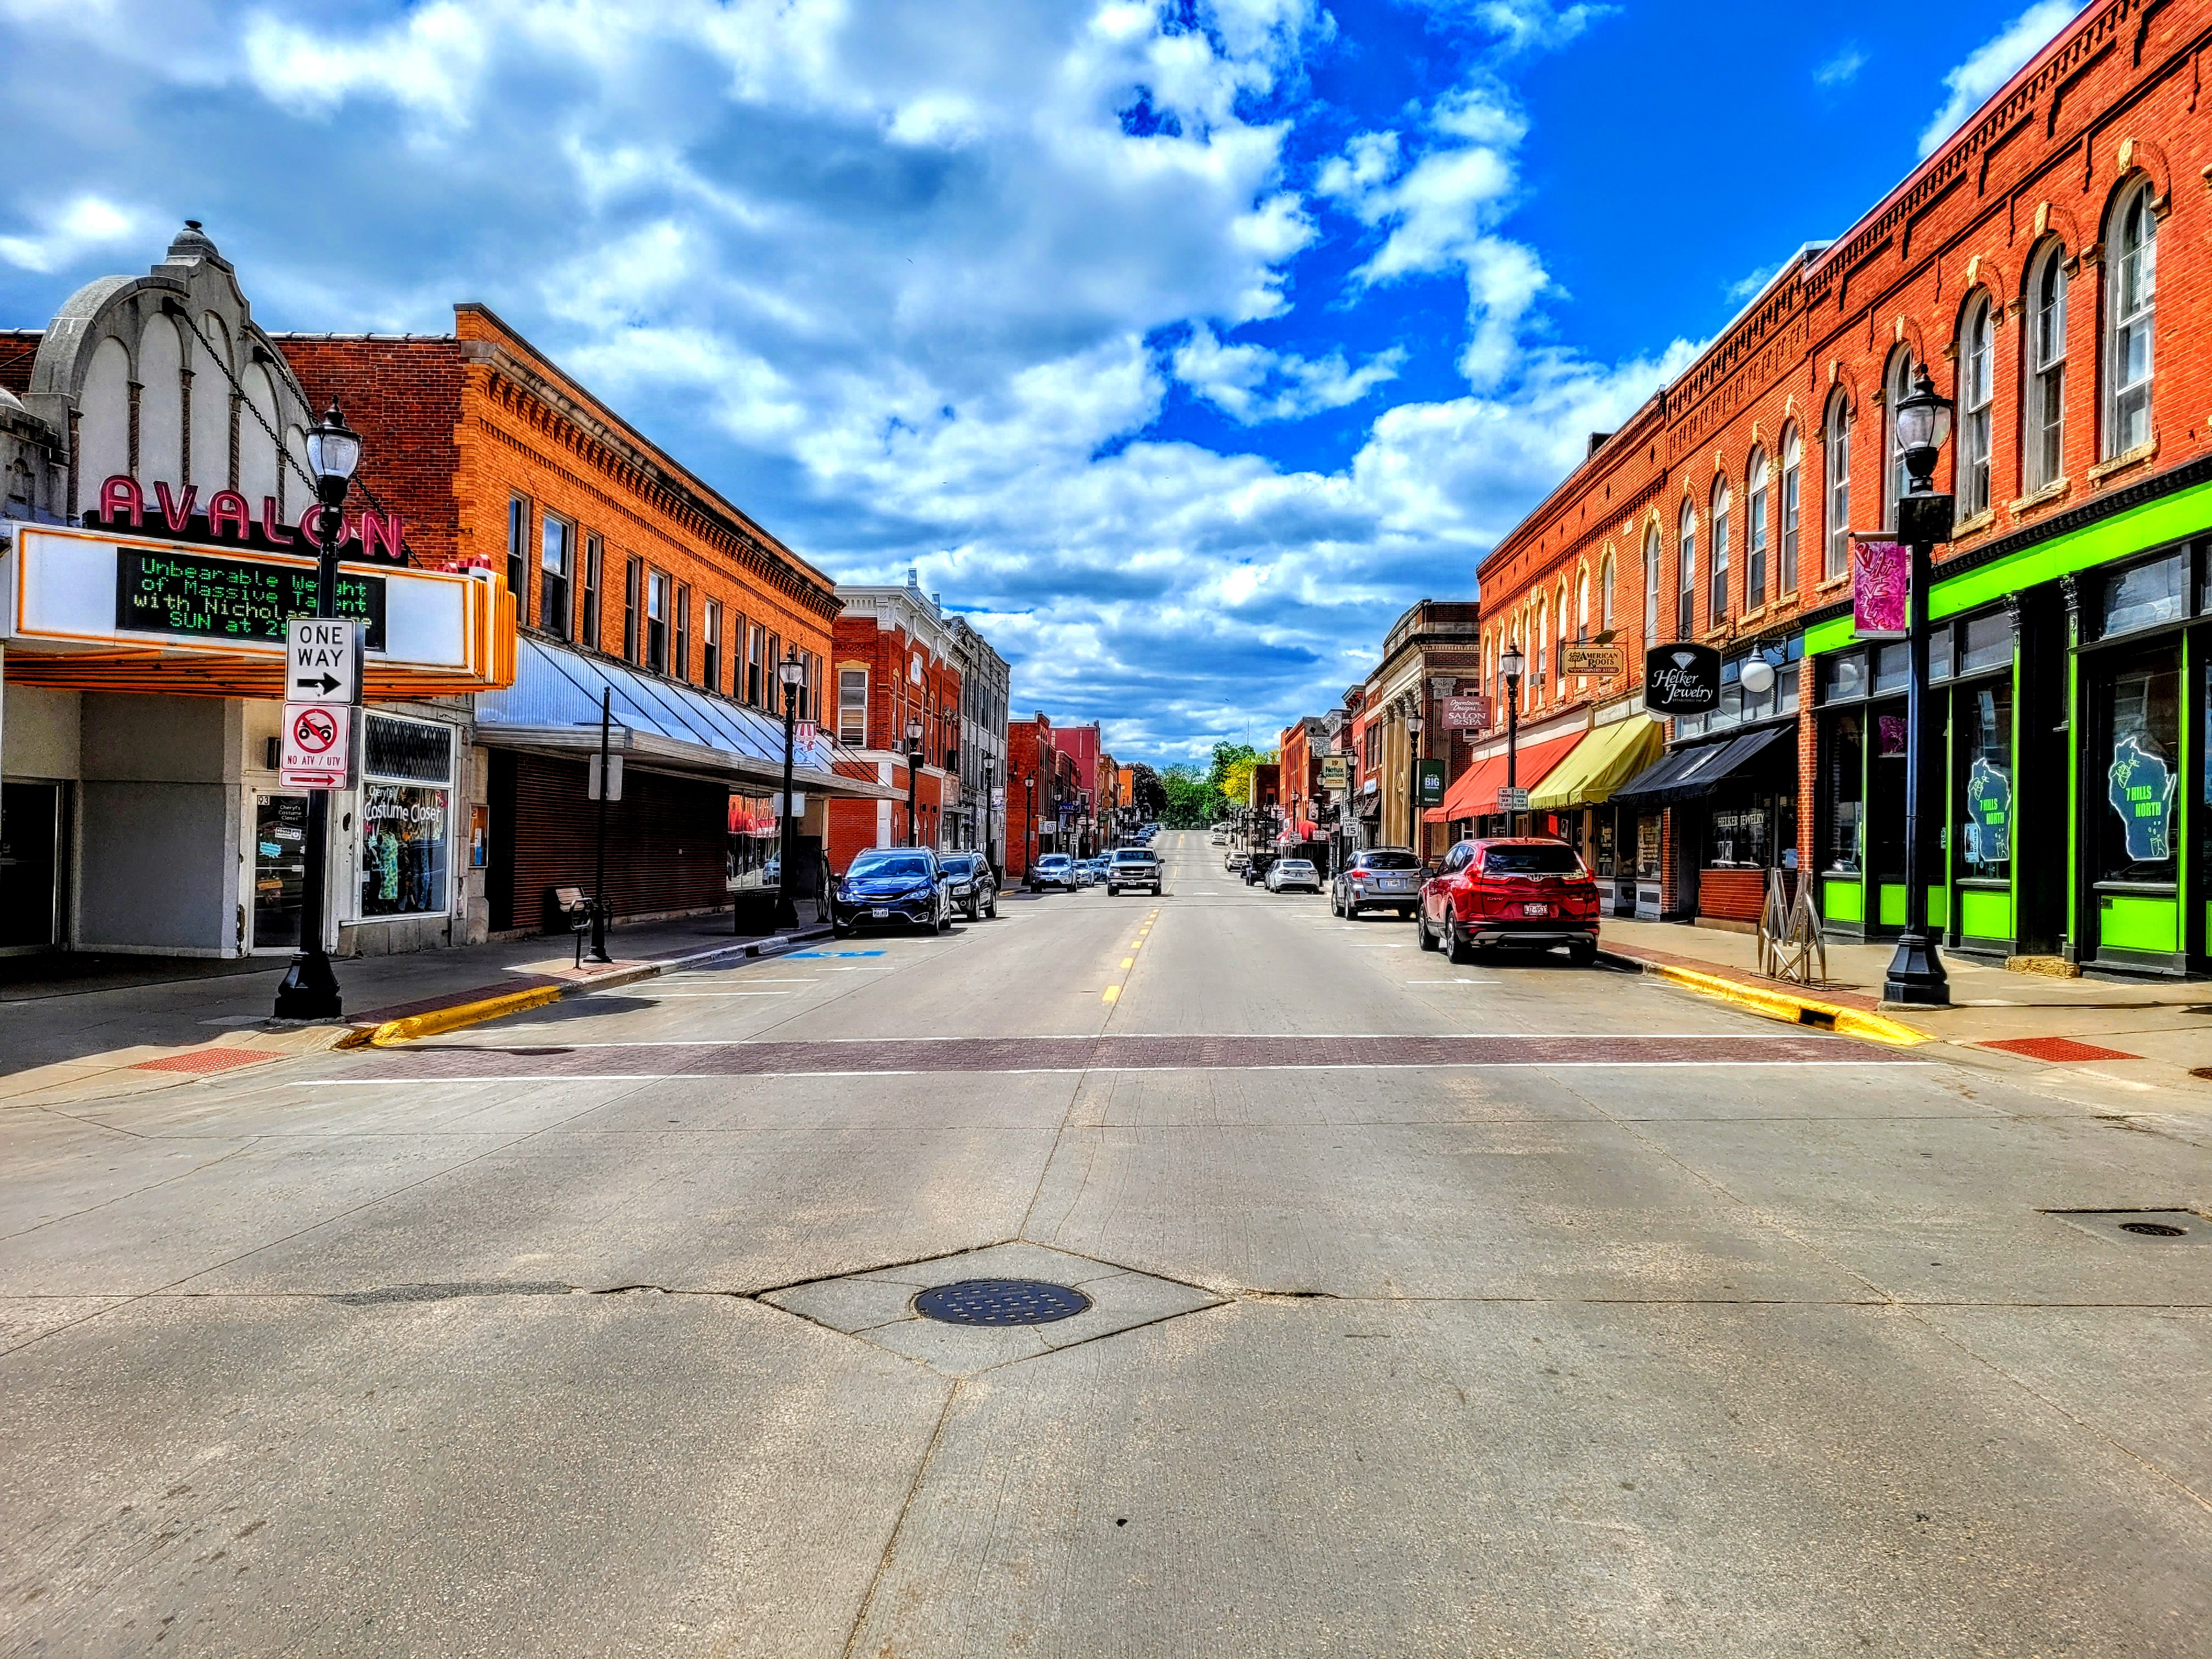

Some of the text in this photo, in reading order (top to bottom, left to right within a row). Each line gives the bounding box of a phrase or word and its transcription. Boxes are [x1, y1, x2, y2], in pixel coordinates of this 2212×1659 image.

[99, 474, 402, 559] AVALON
[142, 557, 278, 587] Unbearable
[142, 577, 168, 591] of
[185, 579, 278, 603] Massive
[134, 592, 190, 611] with
[170, 611, 211, 629] SUN
[225, 618, 251, 633] at
[300, 625, 343, 645] ONE
[297, 648, 344, 667] WAY
[1579, 651, 1618, 661] AMERICAN
[1588, 658, 1615, 668] ROOTS
[1651, 668, 1699, 687] Helker
[1661, 684, 1713, 704] Jewelry
[1453, 704, 1476, 713] Designs
[287, 755, 297, 765] NO
[302, 756, 315, 765] ATV
[327, 757, 341, 766] UTV
[1424, 777, 1440, 786] BIG
[258, 796, 269, 805] 93
[369, 785, 393, 800] Cheryl's
[2125, 785, 2152, 802] 7 HILLS
[364, 802, 441, 823] Costume Closet
[1979, 798, 1997, 811] 7 HILLS
[2135, 802, 2162, 817] NORTH
[1718, 812, 1765, 827] HELKER JEWELRY
[1986, 812, 2005, 825] NORTH
